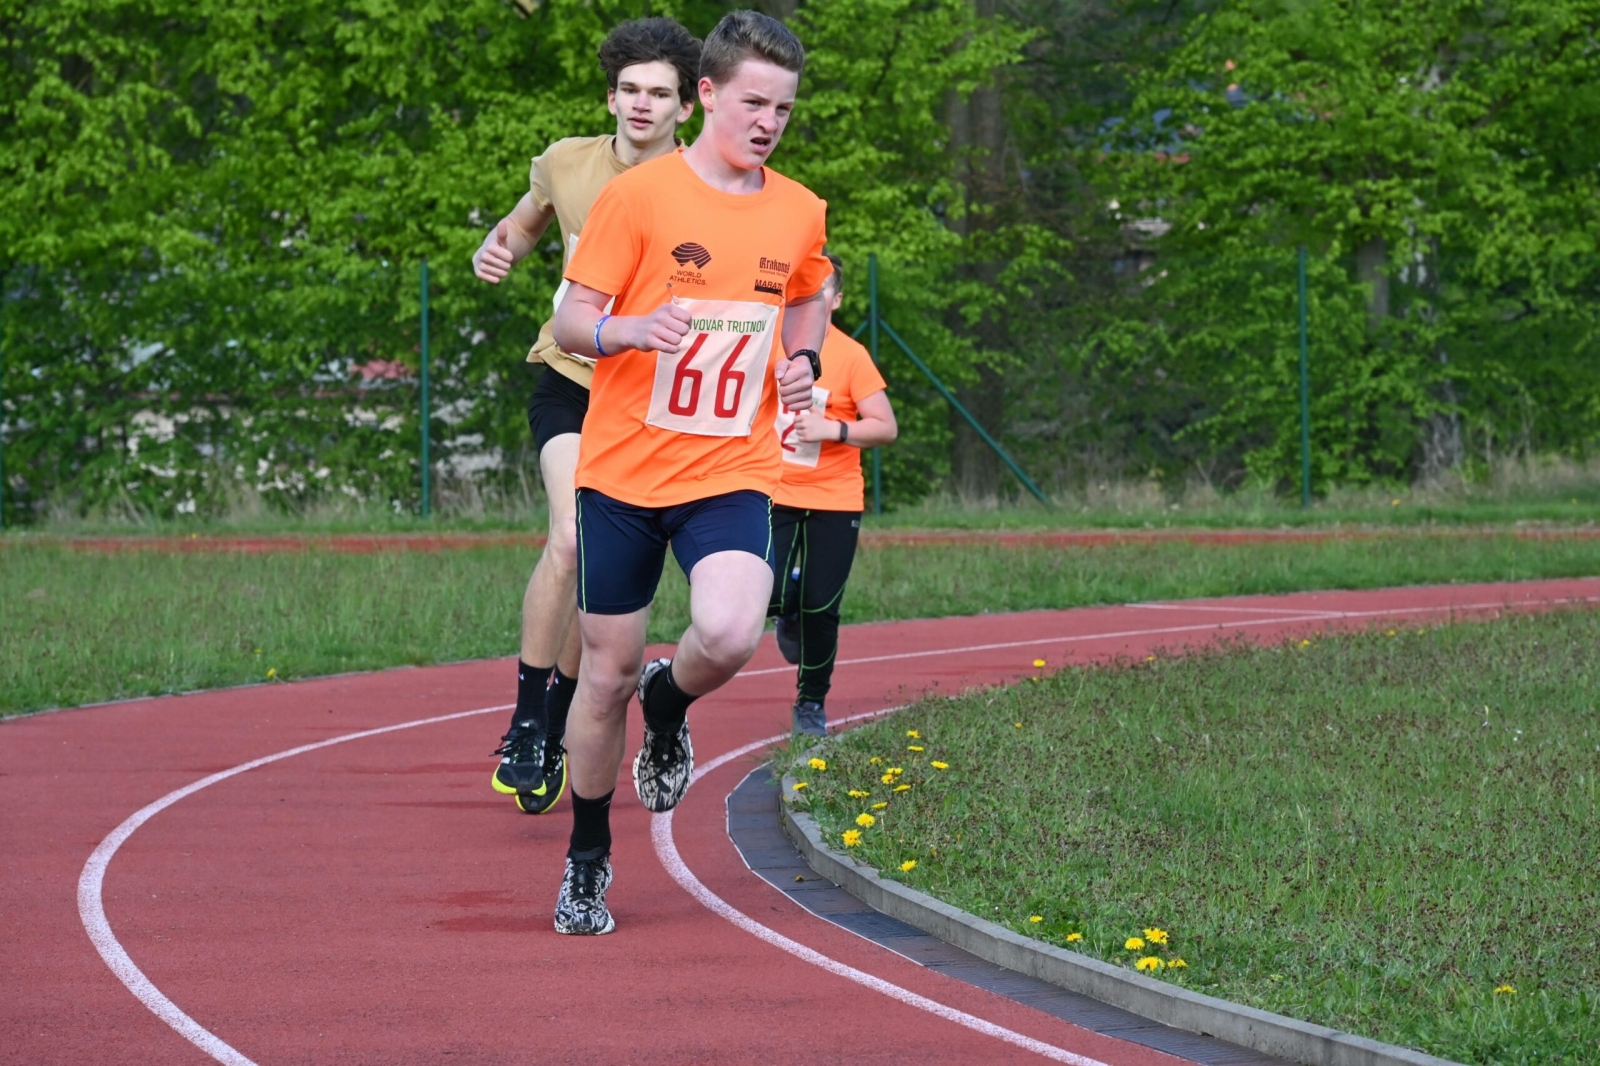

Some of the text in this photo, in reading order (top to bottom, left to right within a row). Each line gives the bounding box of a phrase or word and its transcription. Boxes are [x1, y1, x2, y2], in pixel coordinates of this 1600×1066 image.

[669, 275, 706, 286] ATHLETICS
[676, 270, 702, 279] WORLD
[726, 319, 766, 333] TRUTNOV
[668, 333, 752, 418] 66
